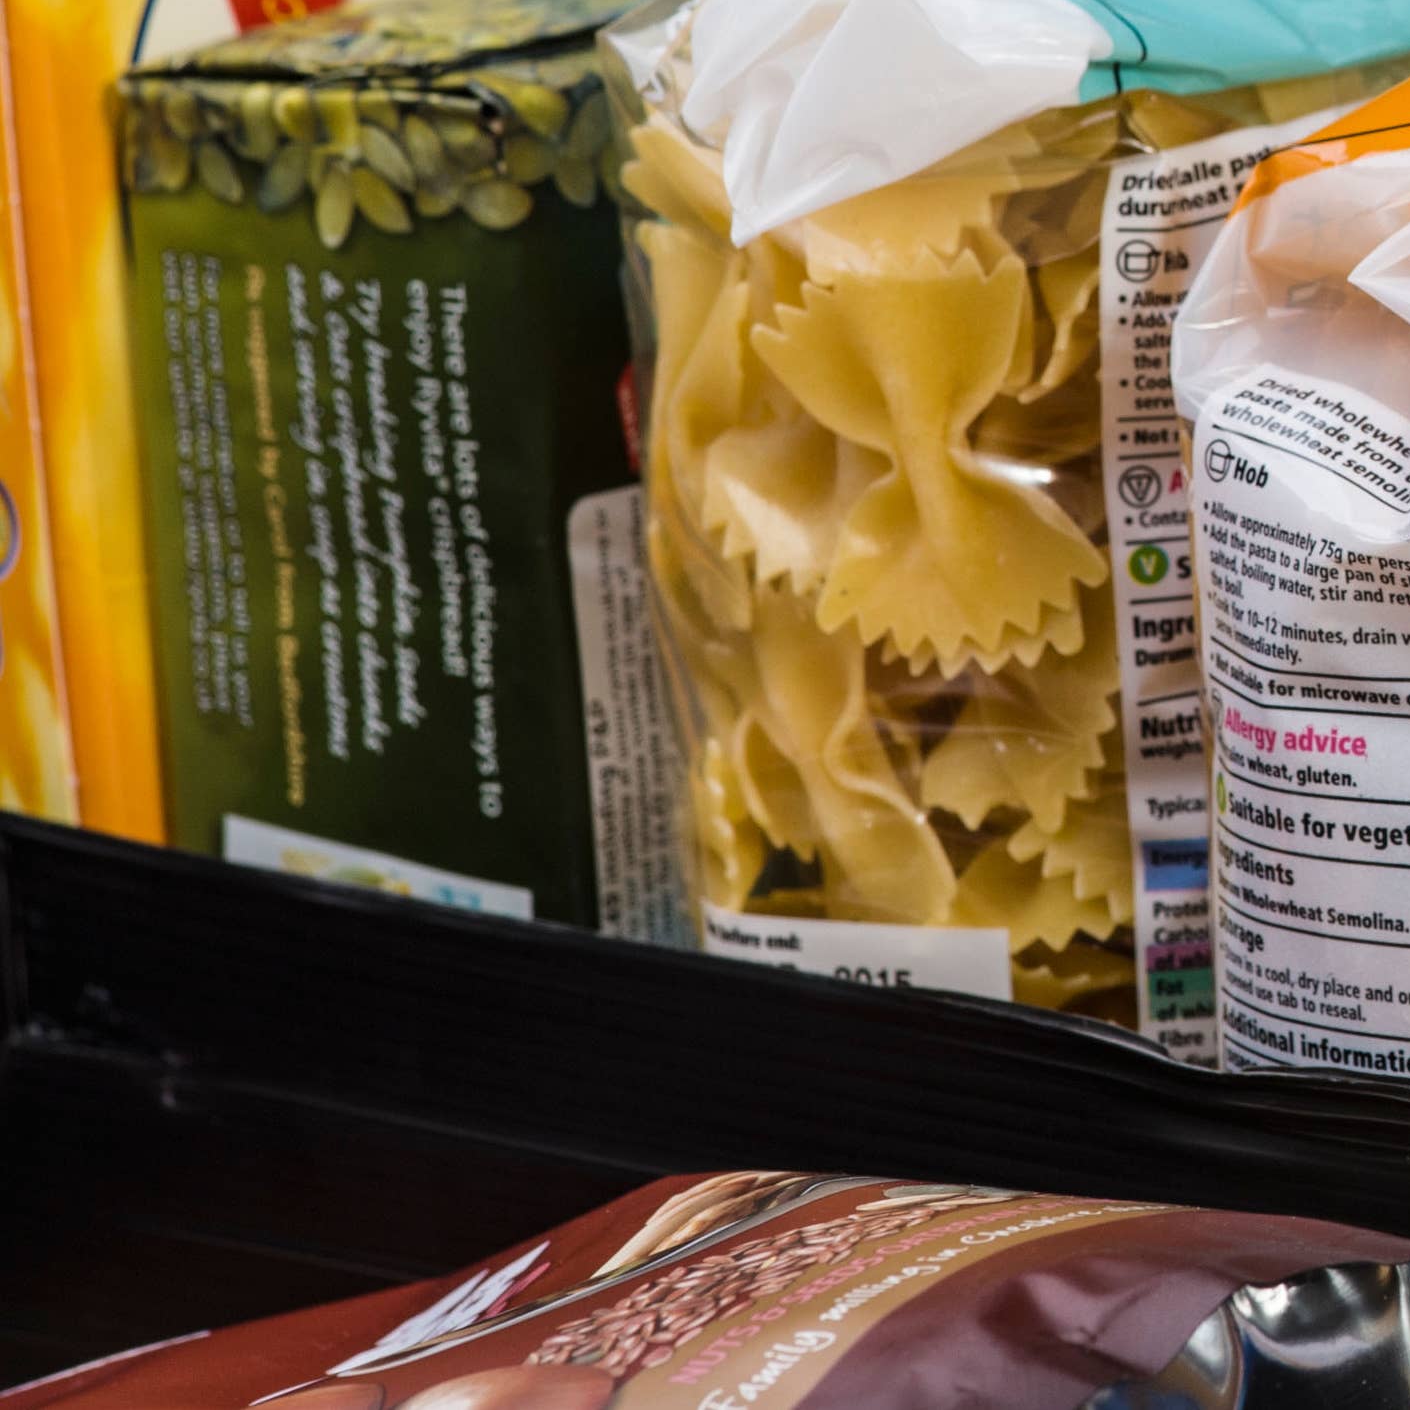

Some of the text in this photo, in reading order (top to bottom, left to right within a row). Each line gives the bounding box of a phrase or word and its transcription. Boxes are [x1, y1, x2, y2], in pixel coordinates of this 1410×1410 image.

[1233, 459, 1269, 488] Hob
[440, 284, 497, 777] There are lots of delicious ways
[1319, 538, 1343, 563] 75g
[1347, 551, 1375, 570] per
[1320, 584, 1348, 601] stir
[1353, 586, 1384, 603] and
[1281, 624, 1348, 645] minutes,
[1353, 628, 1397, 645] drain
[1268, 680, 1295, 696] for
[1300, 683, 1400, 705] microwave
[1224, 707, 1367, 756] Allergy advice
[1229, 793, 1294, 833] Suitable
[1302, 816, 1335, 838] for
[1327, 908, 1410, 933] Semolina.
[668, 1324, 760, 1384] NUTS
